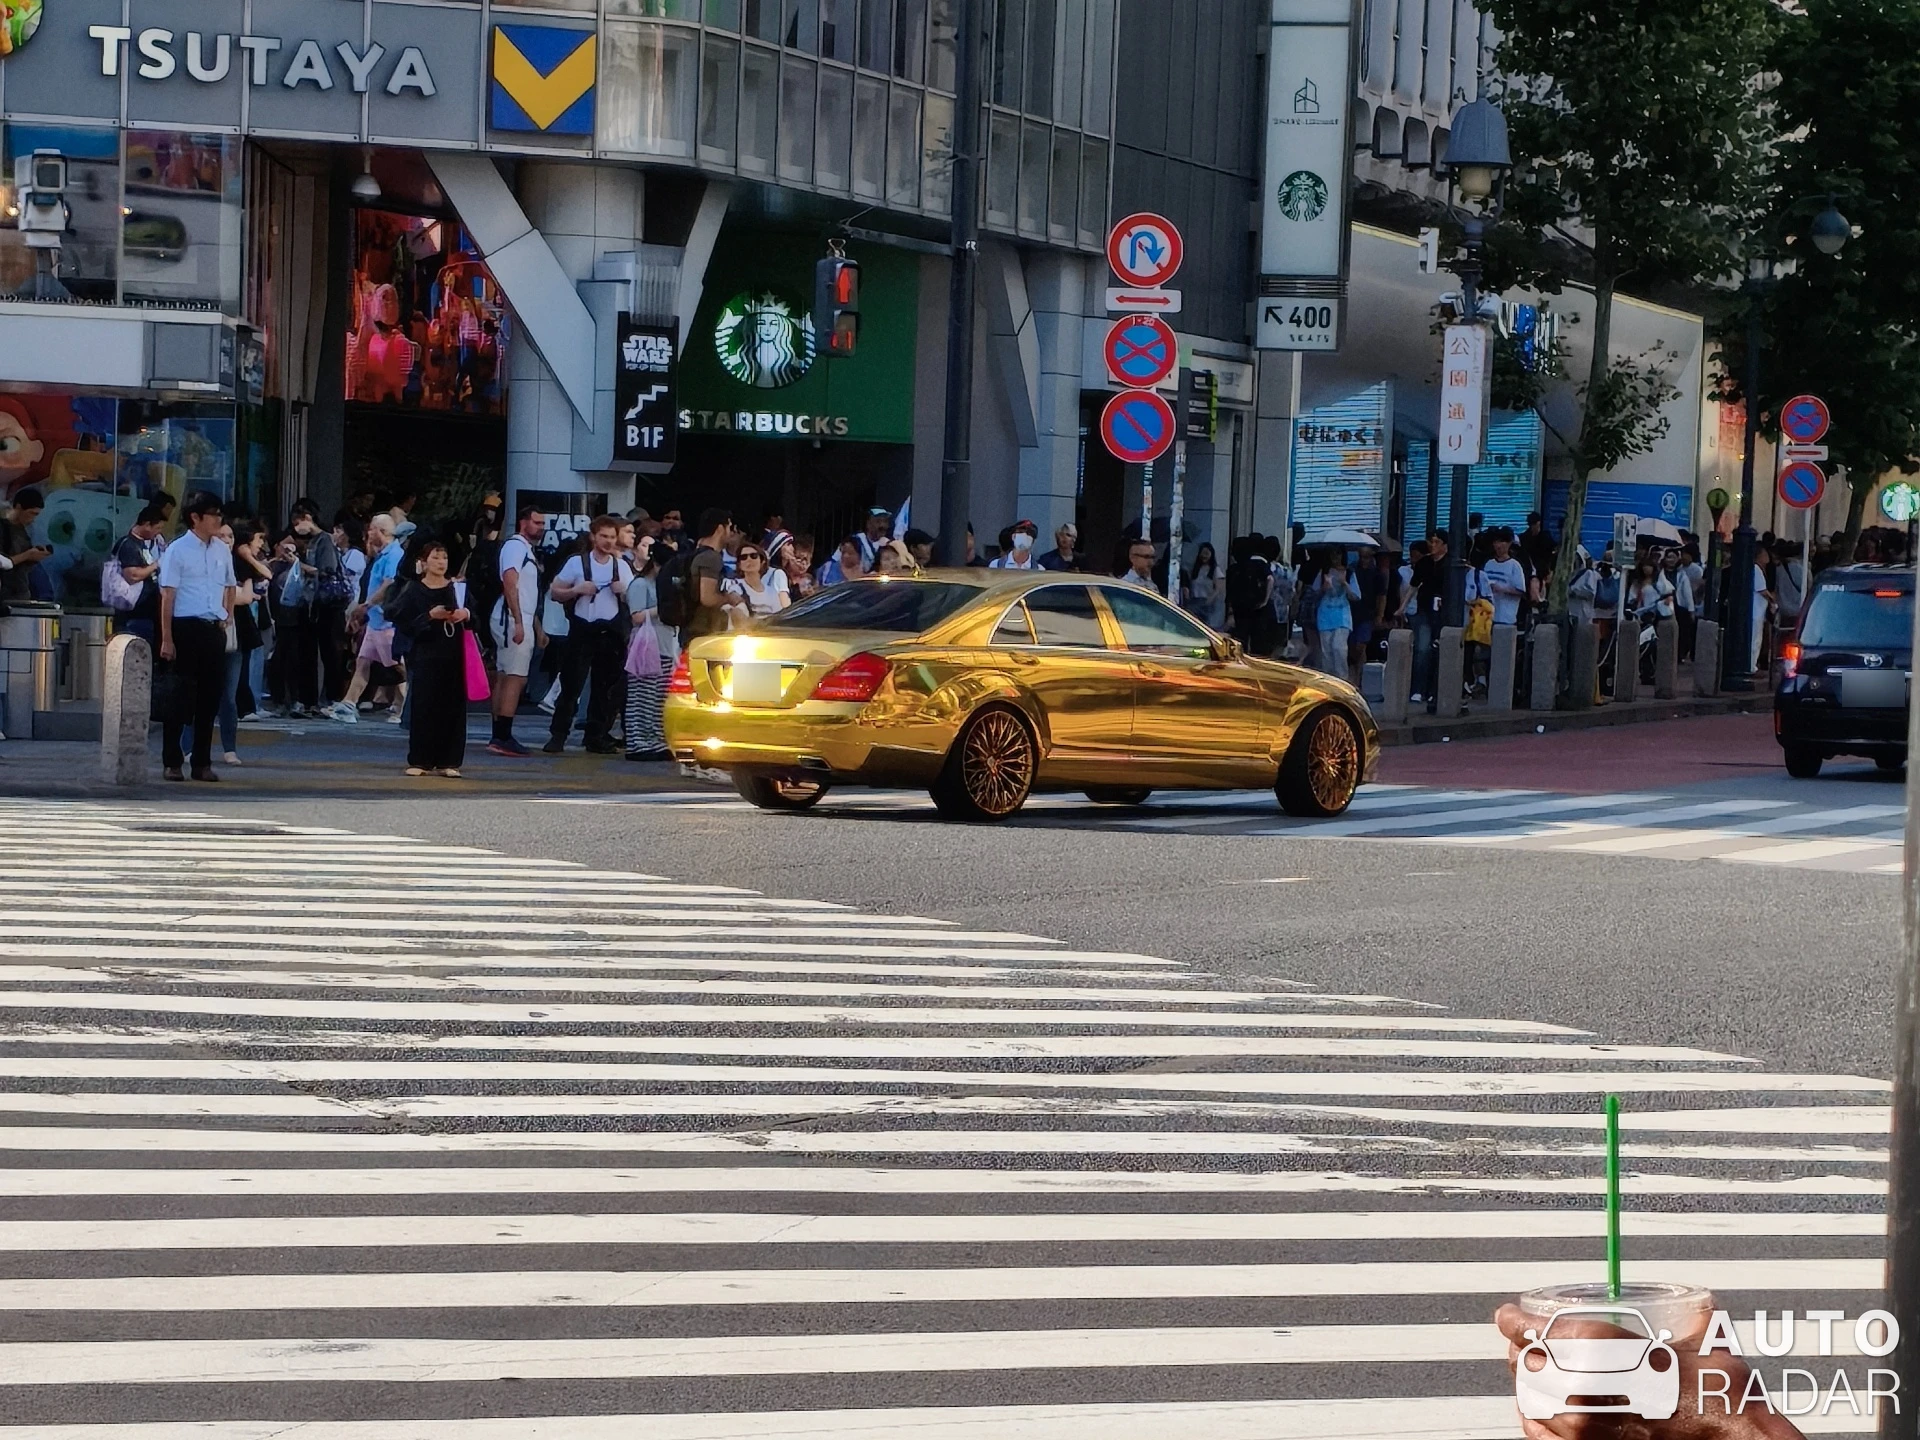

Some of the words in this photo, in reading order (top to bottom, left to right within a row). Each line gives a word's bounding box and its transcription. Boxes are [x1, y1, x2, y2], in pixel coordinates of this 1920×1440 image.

[88, 25, 437, 97] TSUTAYA
[1289, 305, 1331, 328] 400
[622, 334, 673, 351] STAR
[1289, 333, 1330, 343] SEATS
[622, 348, 673, 364] WARS
[678, 408, 849, 436] STARBUCKS
[626, 424, 664, 448] B1F
[544, 513, 592, 532] TAR
